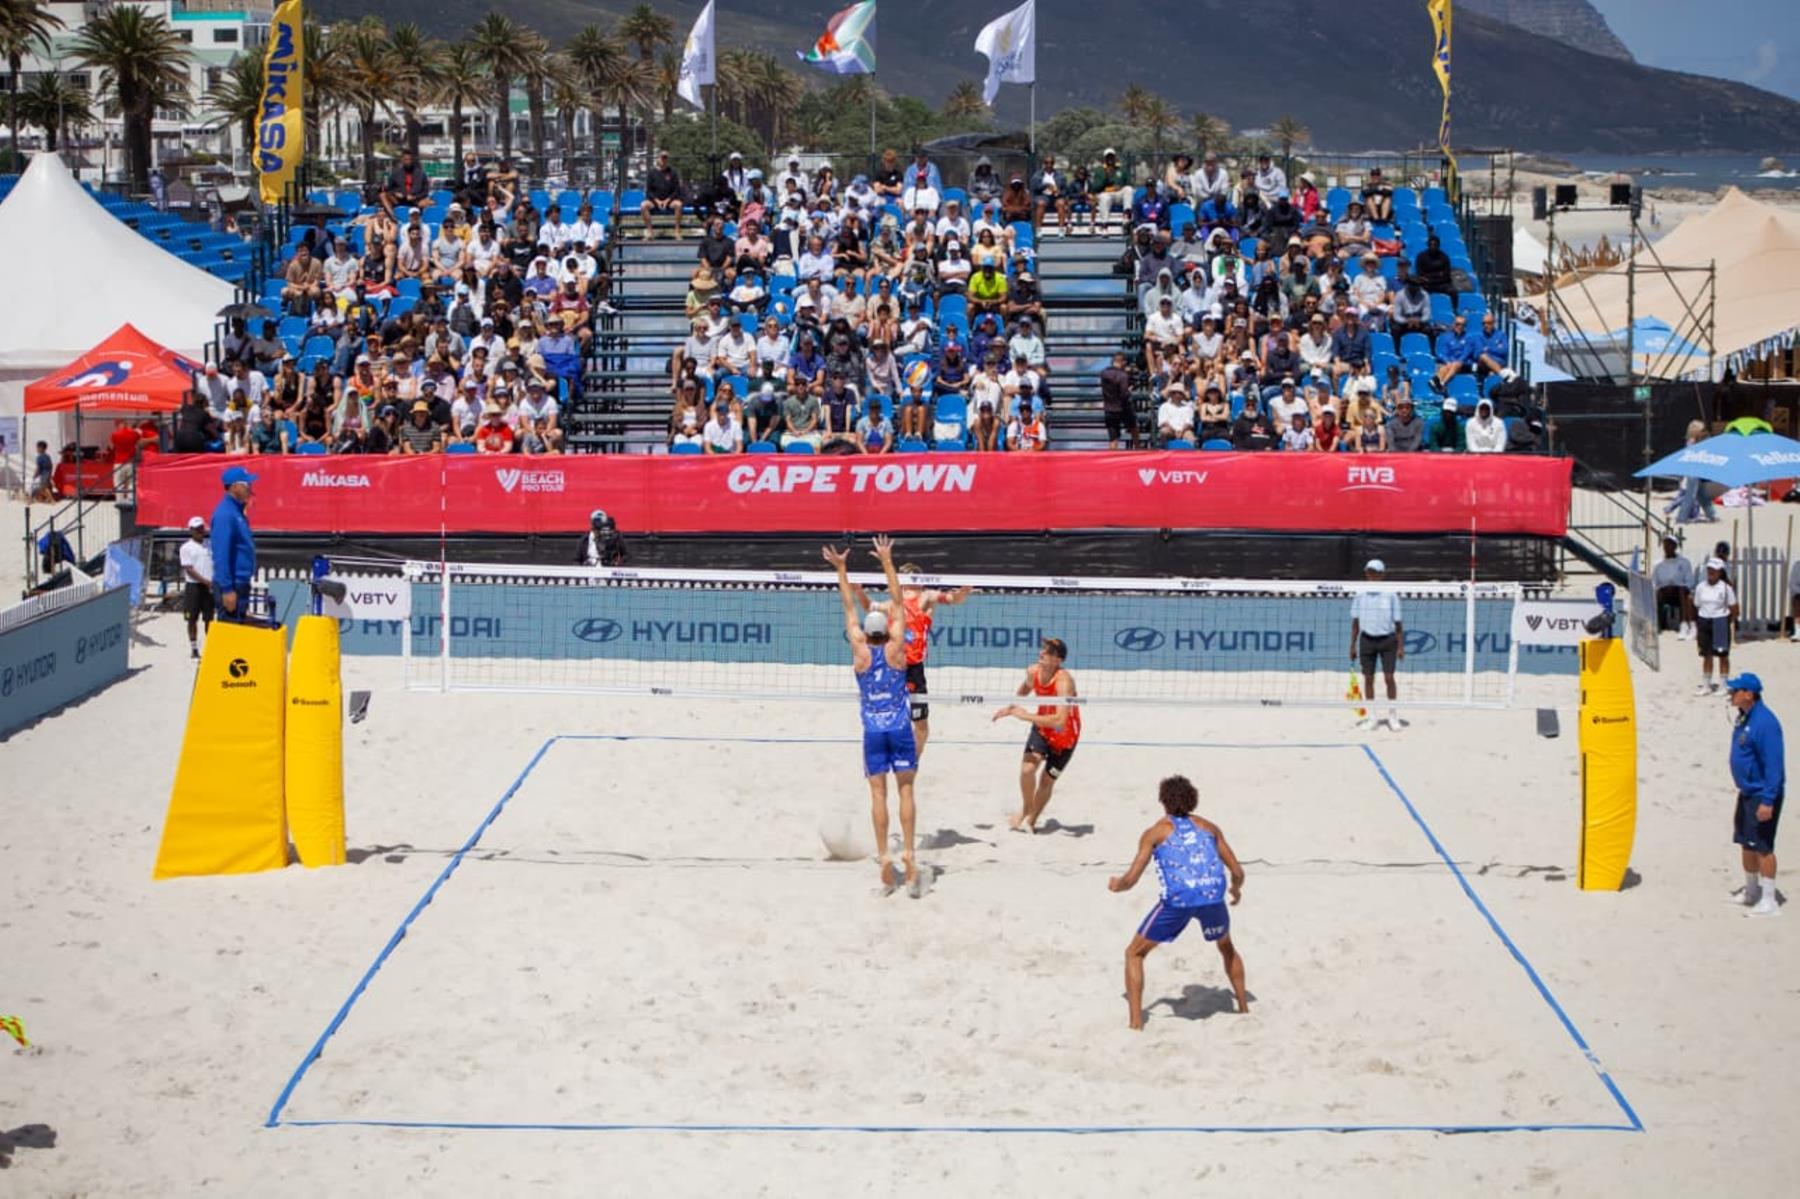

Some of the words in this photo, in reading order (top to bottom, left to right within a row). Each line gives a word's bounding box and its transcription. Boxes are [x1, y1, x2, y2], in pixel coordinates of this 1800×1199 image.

[522, 473, 564, 484] BEACH
[727, 464, 841, 493] CAPE
[850, 464, 977, 493] TOWN
[1159, 471, 1208, 483] VBTV
[350, 593, 398, 605] VBTV
[632, 620, 771, 643] HYUNDAI
[928, 627, 1042, 649] YUNDAI
[1175, 629, 1314, 652] HYUNDAI
[16, 651, 56, 688] HYUNDAI
[221, 681, 257, 689] Senoh
[1183, 832, 1197, 845] 2
